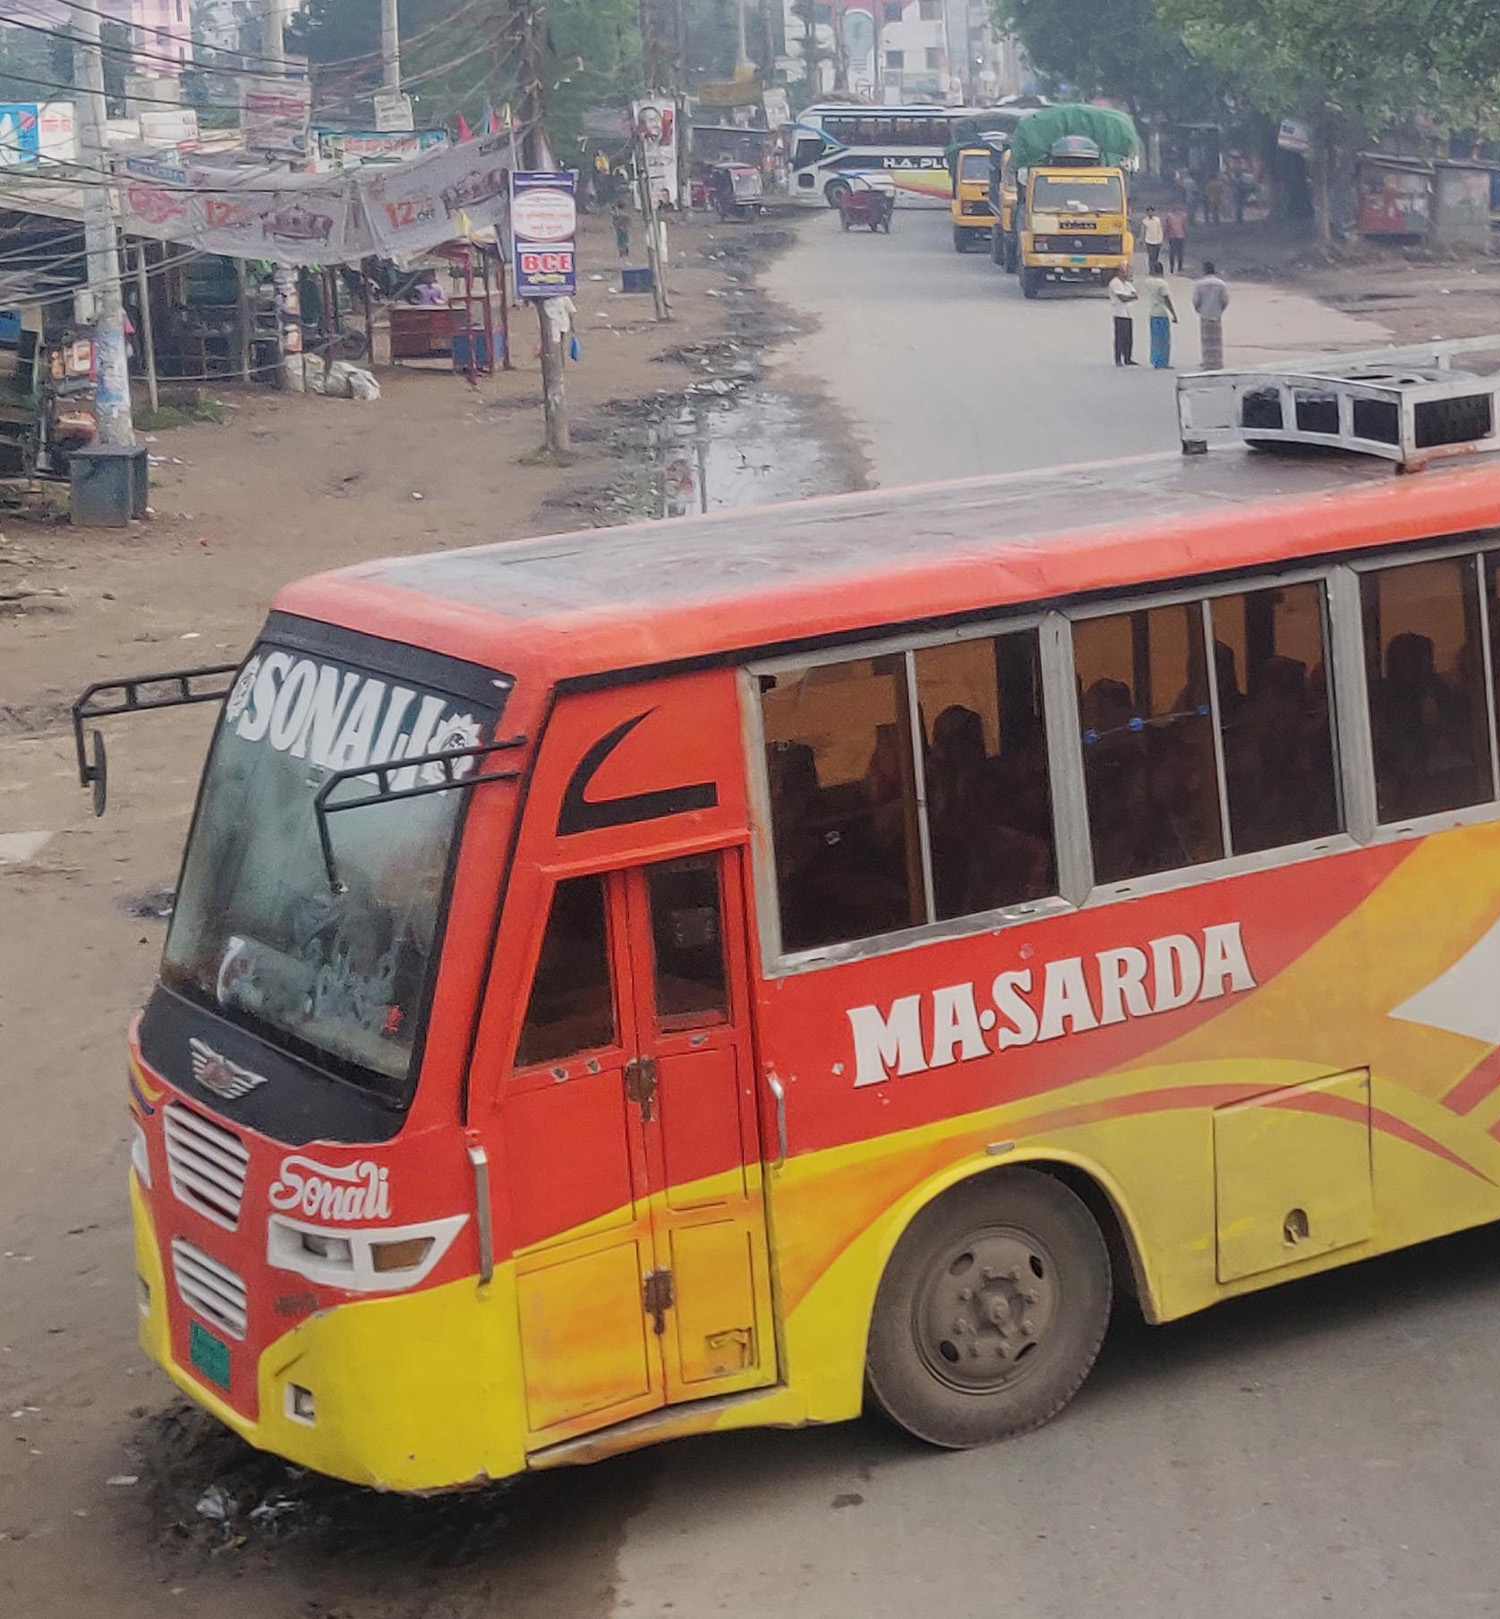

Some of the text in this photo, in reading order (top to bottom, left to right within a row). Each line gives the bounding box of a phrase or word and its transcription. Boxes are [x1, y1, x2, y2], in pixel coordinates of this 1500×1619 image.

[521, 253, 573, 273] BCE
[236, 651, 449, 792] SONALI
[268, 1154, 392, 1221] Sonali
